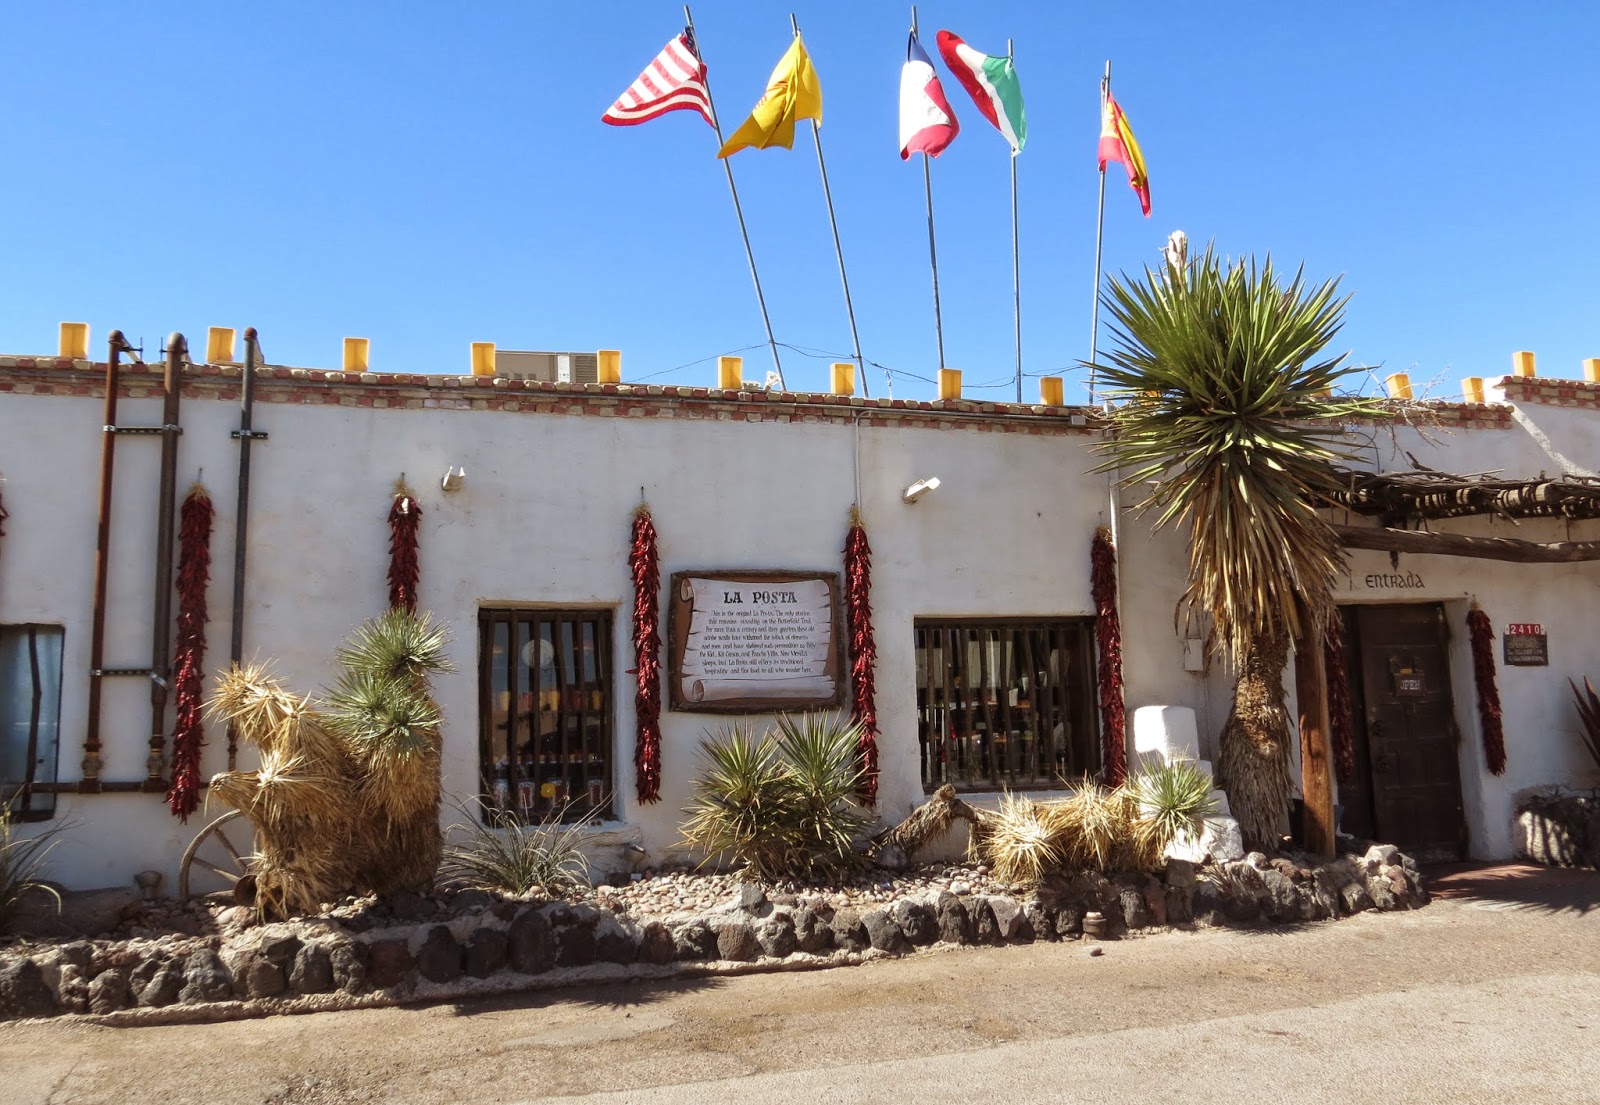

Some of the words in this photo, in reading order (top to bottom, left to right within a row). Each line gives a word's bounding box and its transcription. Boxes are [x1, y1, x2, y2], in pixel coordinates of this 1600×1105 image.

[723, 591, 743, 604] LA
[752, 591, 797, 604] POSTA
[736, 610, 751, 618] original
[784, 610, 794, 618] only
[780, 626, 796, 634] quarters
[1510, 624, 1540, 635] 2410
[704, 668, 728, 676] hospitality
